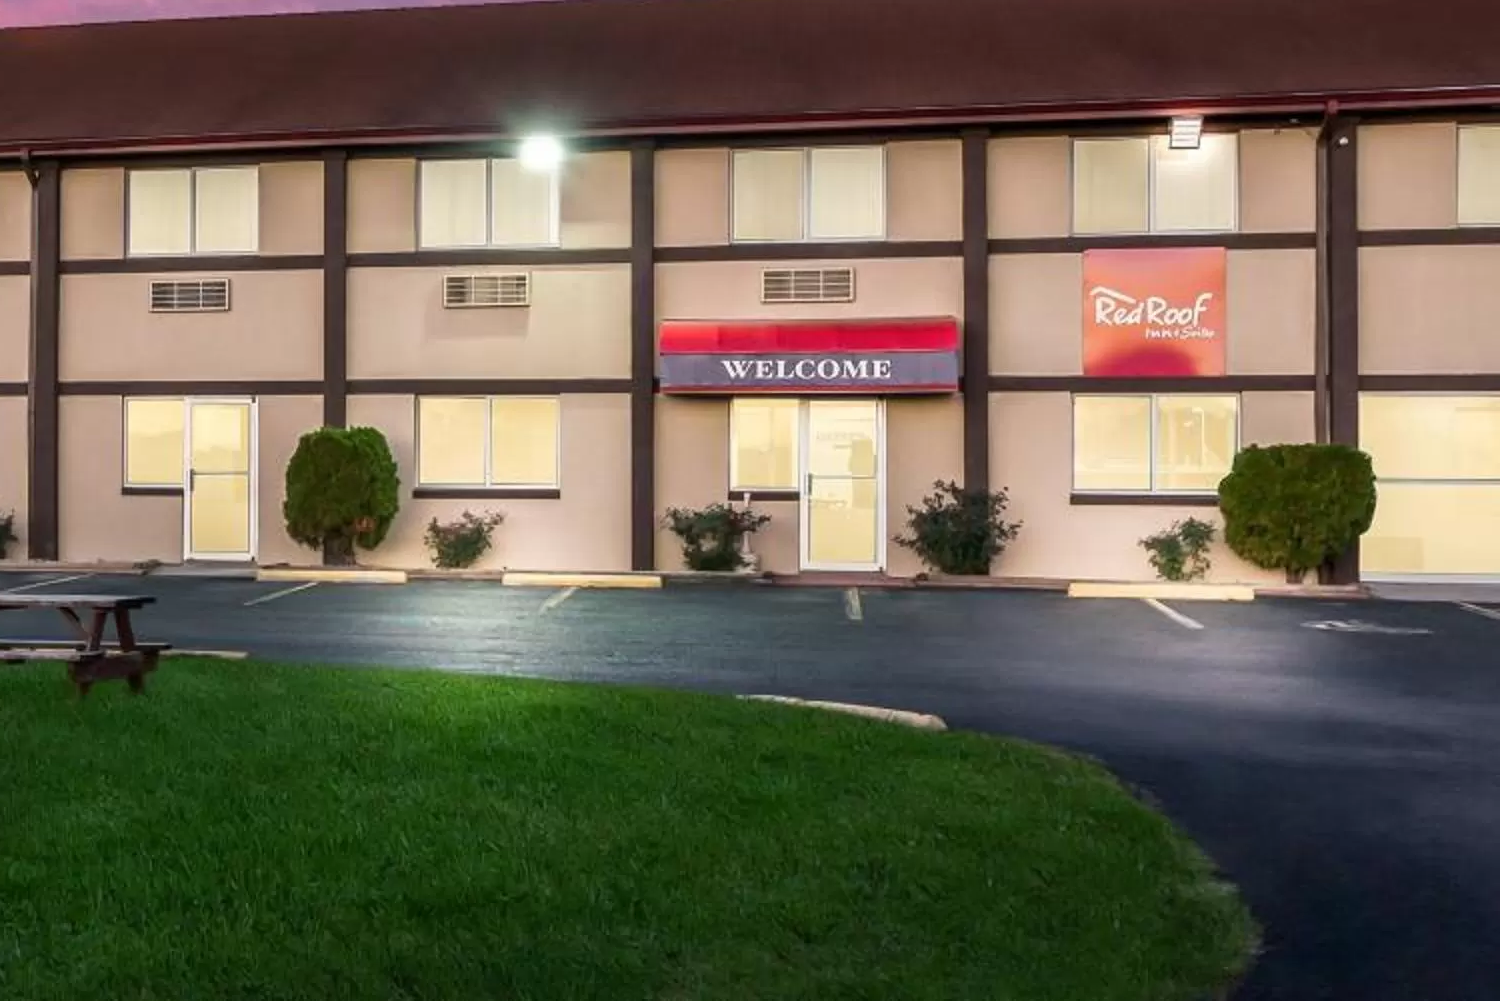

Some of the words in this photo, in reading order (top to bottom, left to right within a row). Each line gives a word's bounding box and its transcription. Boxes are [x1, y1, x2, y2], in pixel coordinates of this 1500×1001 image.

[1094, 296, 1145, 325] Red
[1146, 292, 1213, 327] Roof
[721, 358, 892, 380] WELCOME
